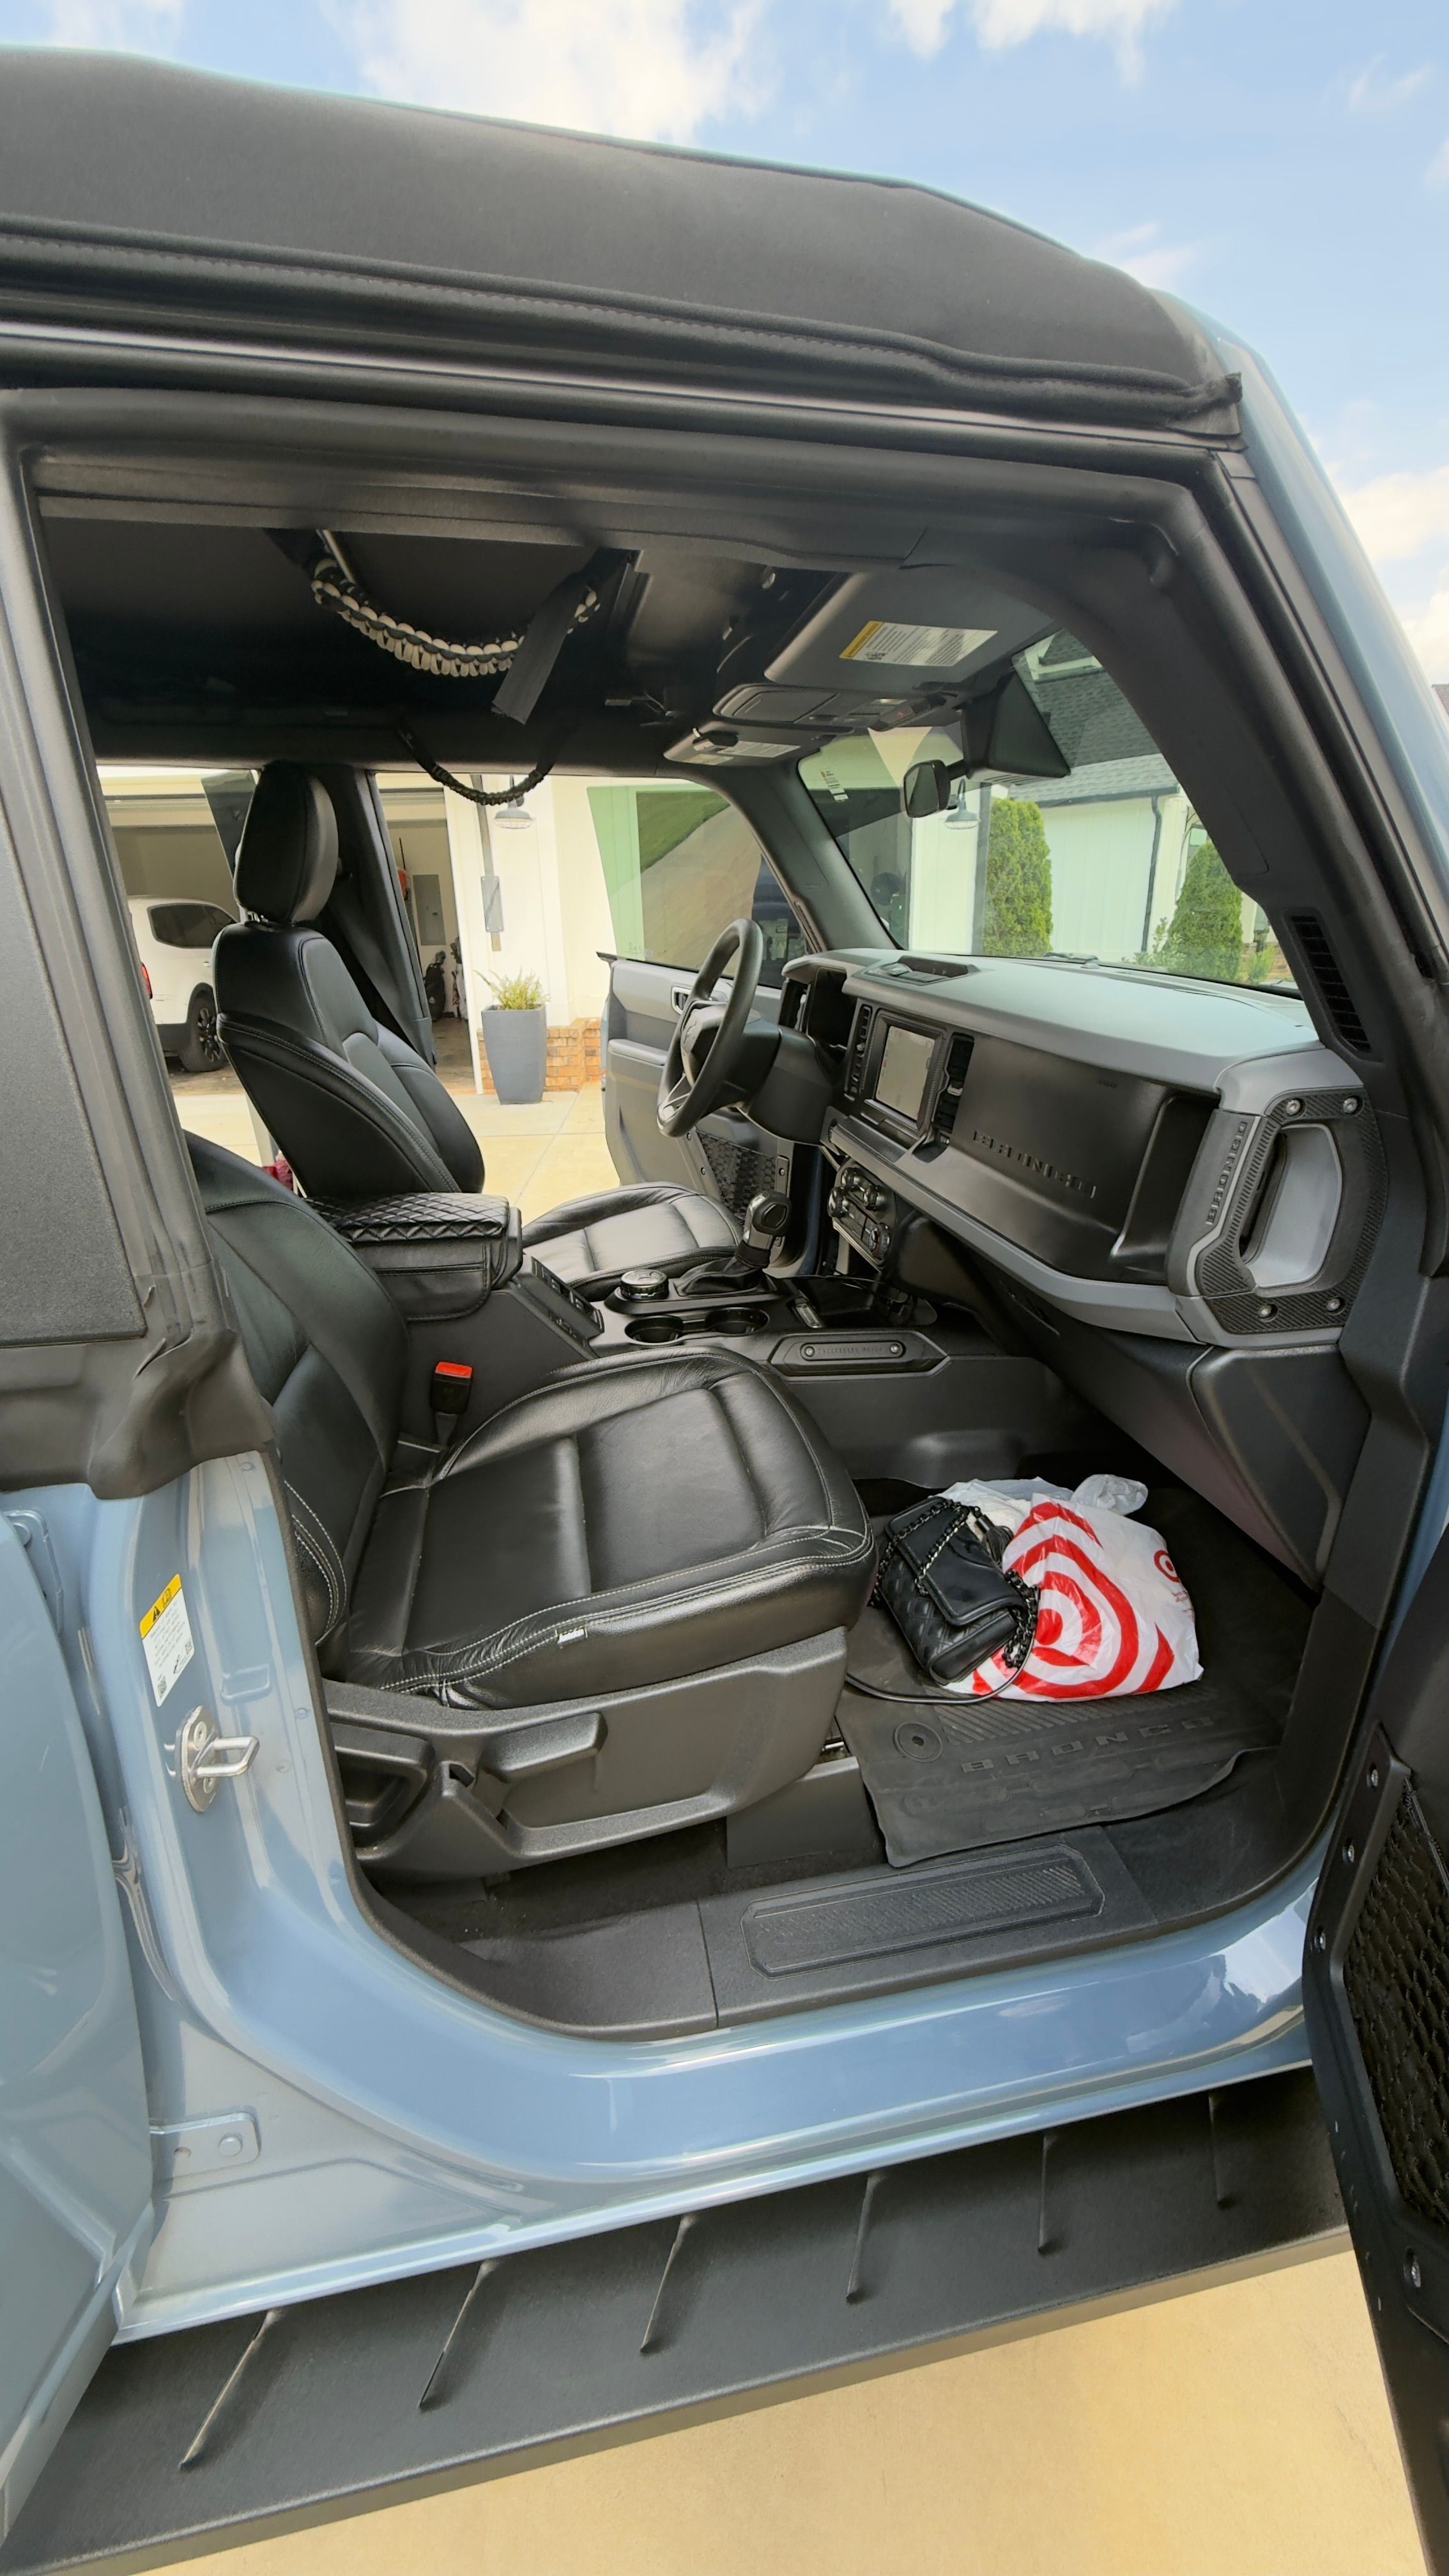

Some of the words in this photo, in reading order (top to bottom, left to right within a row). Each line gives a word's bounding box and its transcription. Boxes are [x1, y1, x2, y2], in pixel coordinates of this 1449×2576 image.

[972, 1130, 1097, 1199] BRONCO
[1206, 1121, 1248, 1225] BRONCO
[960, 1715, 1214, 1774] BRONCO
